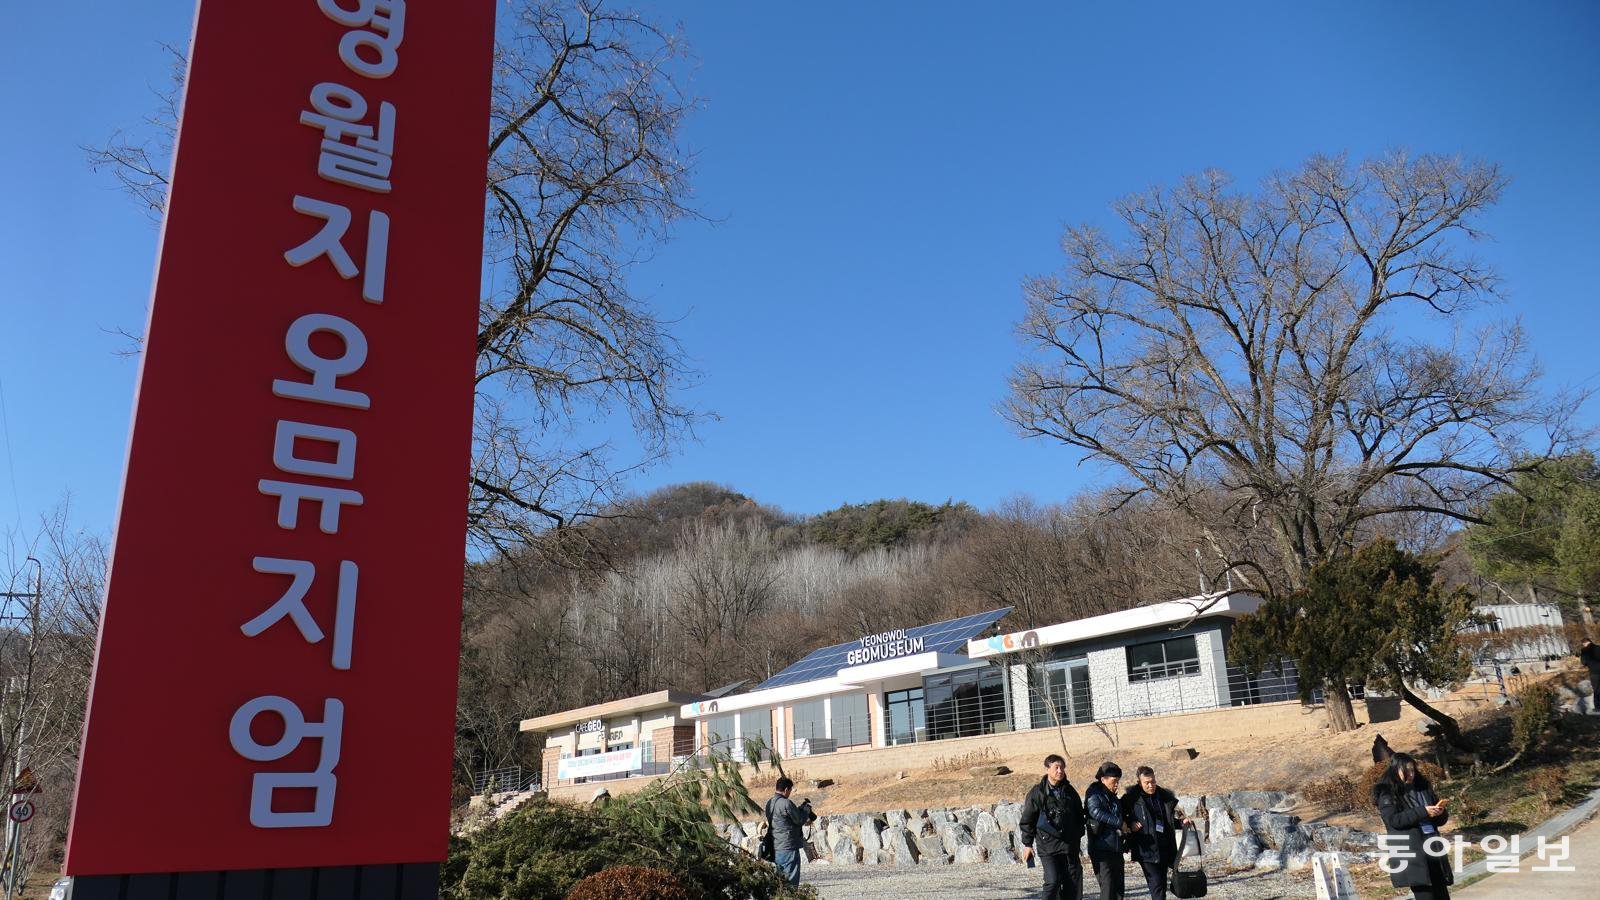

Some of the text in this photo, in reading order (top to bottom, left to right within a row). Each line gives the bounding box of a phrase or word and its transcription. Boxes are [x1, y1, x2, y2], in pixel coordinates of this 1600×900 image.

[228, 0, 406, 829] 영월지오뮤지엄
[847, 637, 924, 665] GEOMUSEUM
[860, 629, 907, 647] YEONGWOL
